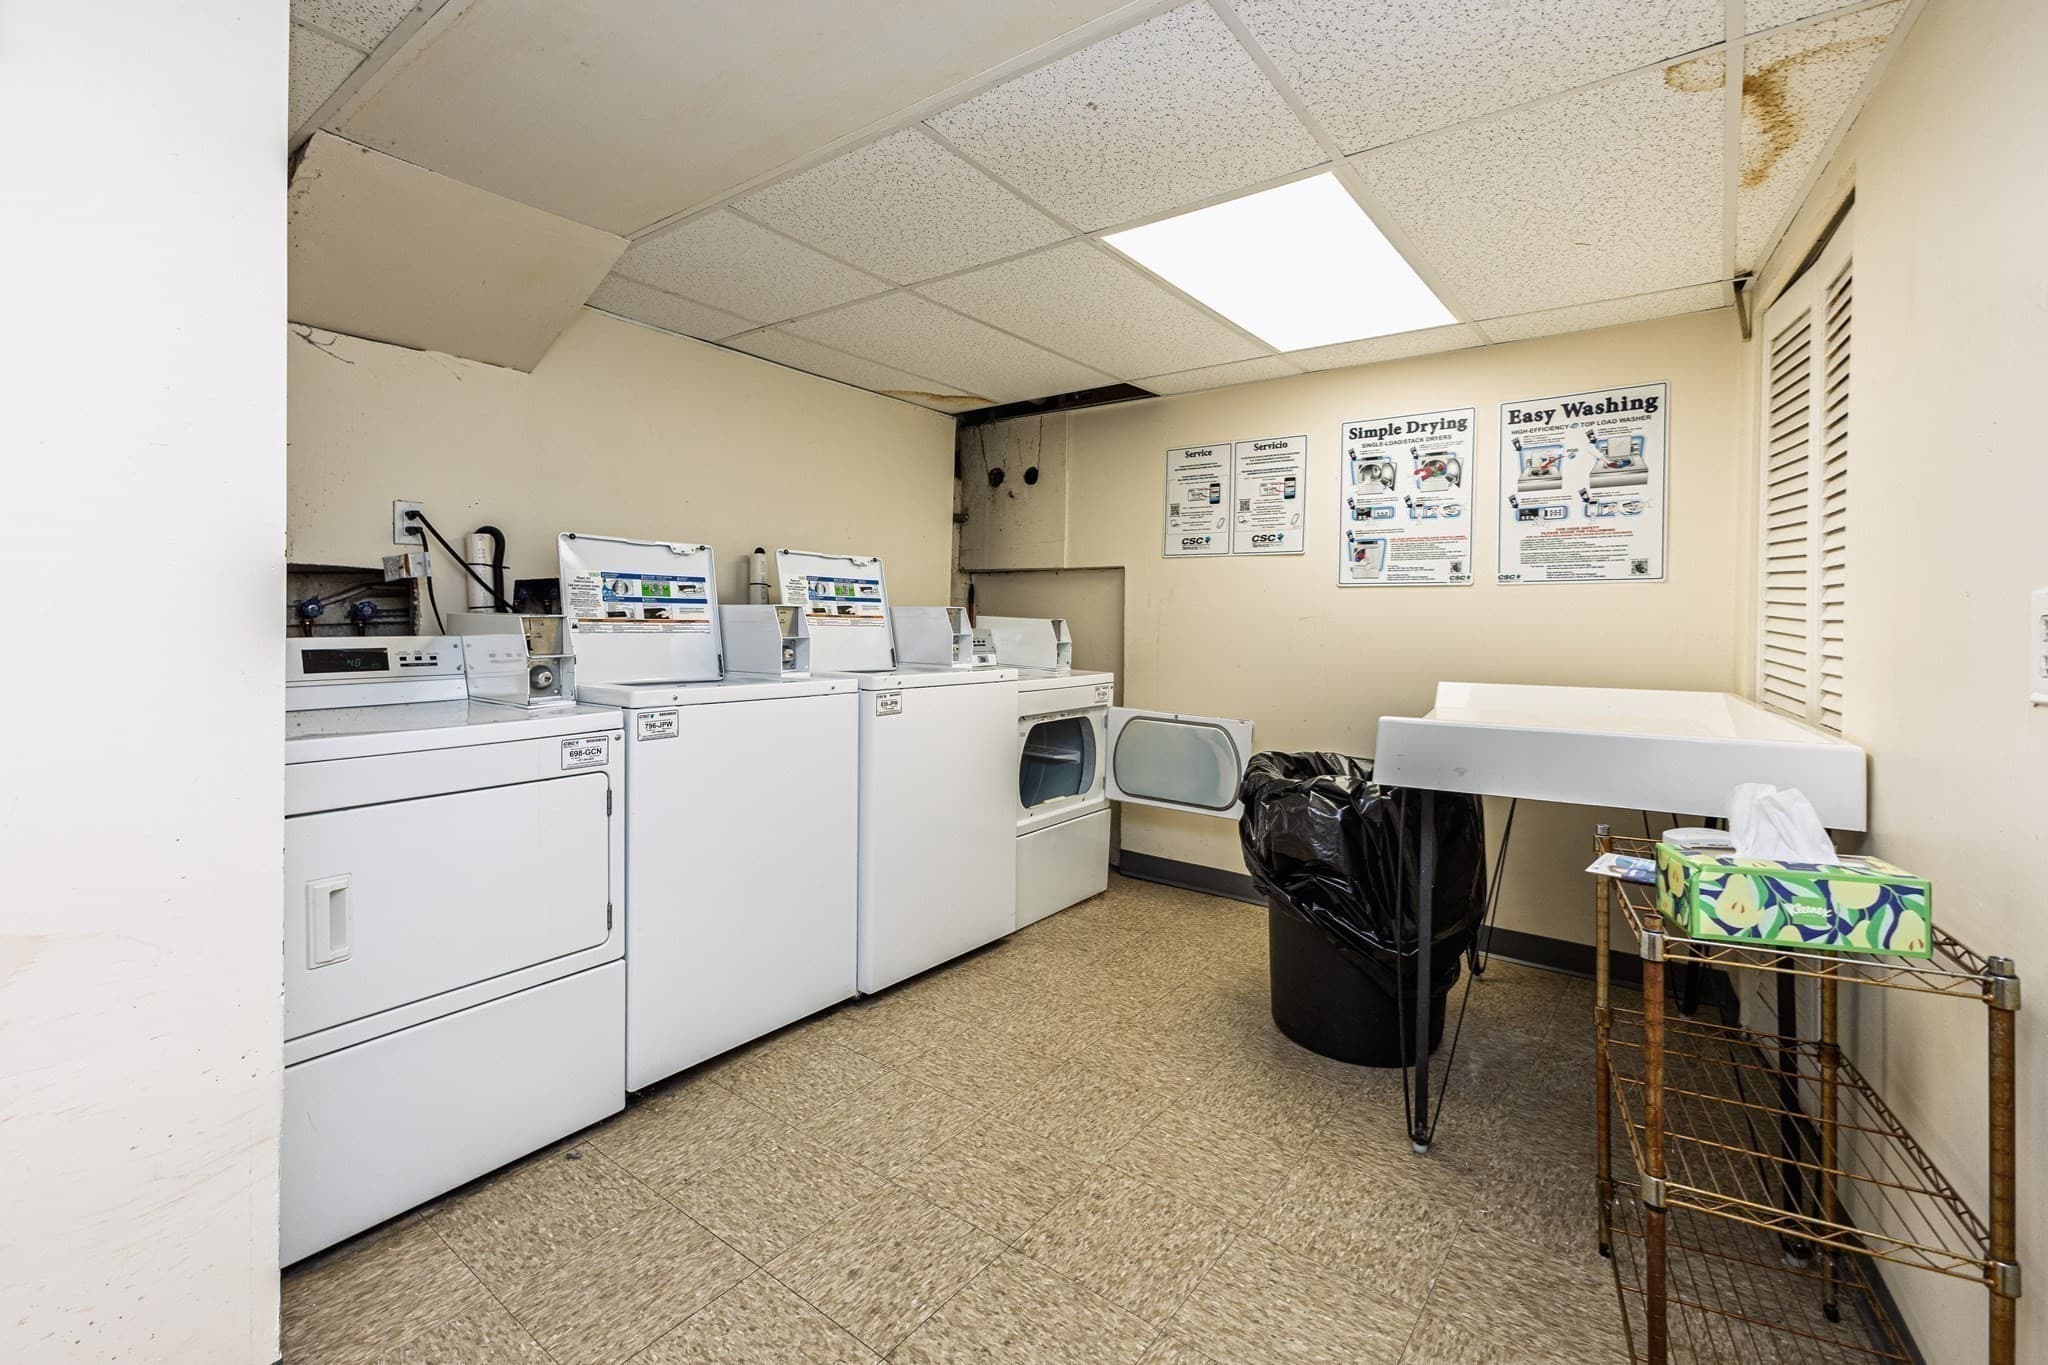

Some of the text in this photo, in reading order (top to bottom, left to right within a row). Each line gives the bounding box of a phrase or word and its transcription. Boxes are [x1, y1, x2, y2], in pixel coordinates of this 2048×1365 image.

[1508, 396, 1659, 425] Easy Washing
[1597, 418, 1617, 426] LOAD
[1619, 415, 1652, 423] WASHER
[1348, 418, 1468, 440] Simple Drying
[1511, 423, 1569, 435] HIGH-EFFICIENCY
[1254, 441, 1288, 451] Servicio
[1184, 449, 1213, 458] Service
[1181, 537, 1204, 545] CSC
[1252, 534, 1276, 543] CSC
